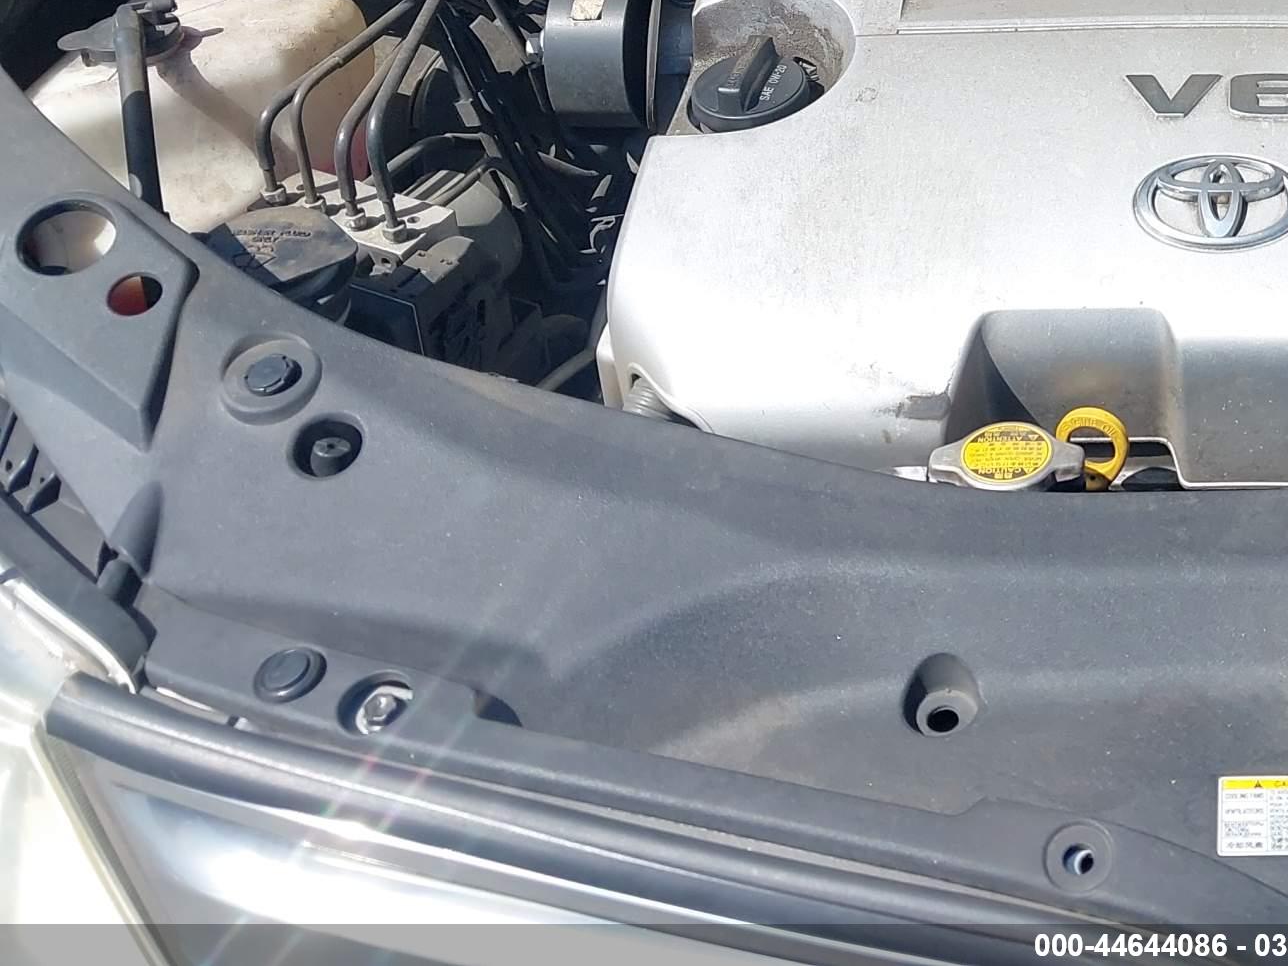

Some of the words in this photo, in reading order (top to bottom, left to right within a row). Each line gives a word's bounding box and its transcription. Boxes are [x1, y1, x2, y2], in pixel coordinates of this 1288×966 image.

[759, 86, 775, 102] SAE
[768, 64, 788, 84] 0W-20
[977, 467, 1022, 475] CAUTION
